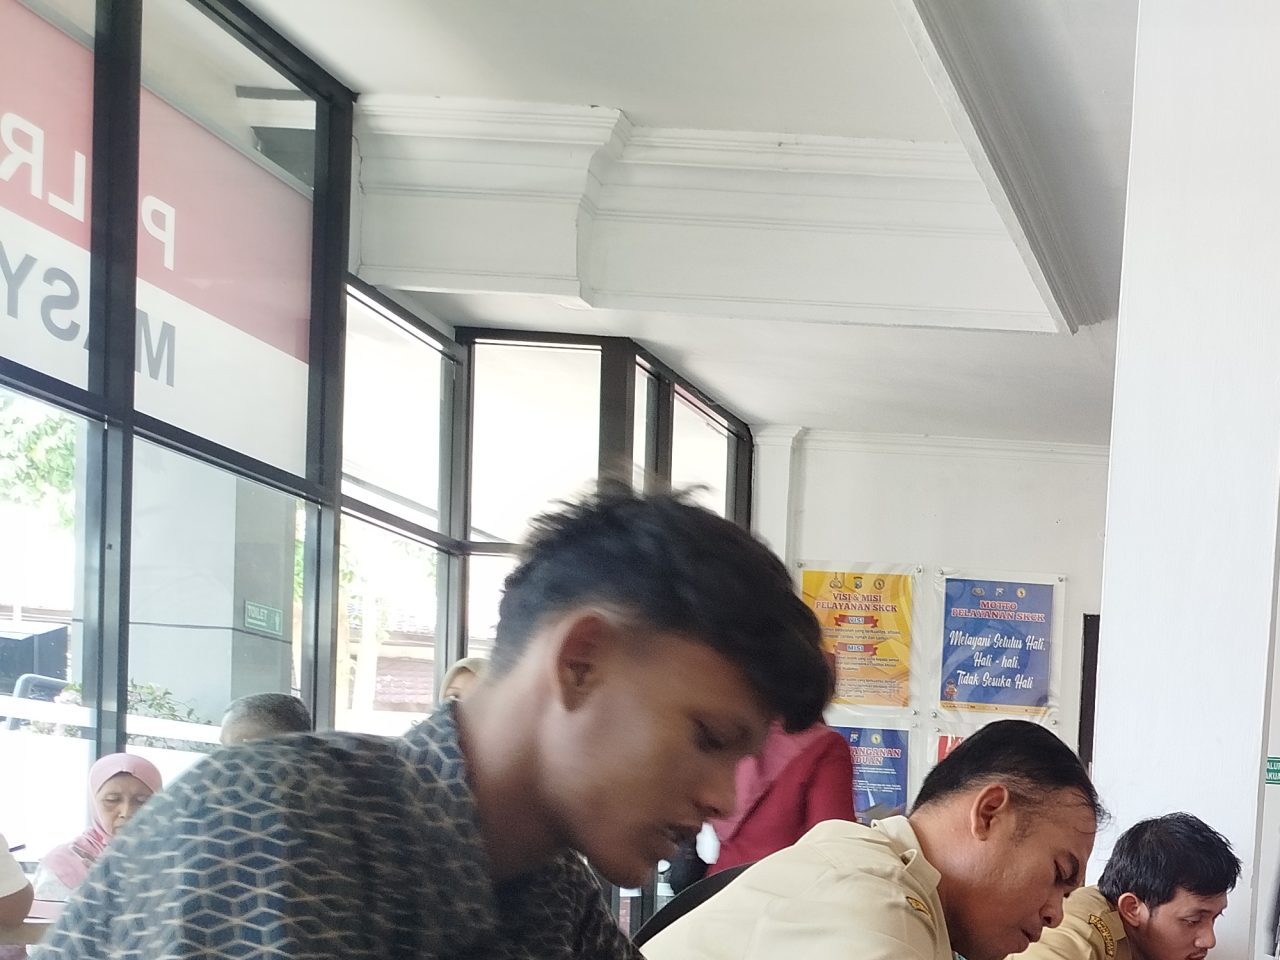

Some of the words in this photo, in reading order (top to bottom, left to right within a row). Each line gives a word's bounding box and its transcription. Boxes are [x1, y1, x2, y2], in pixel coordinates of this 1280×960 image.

[833, 592, 851, 602] VISI
[852, 593, 859, 601] &
[861, 594, 882, 603] MISI
[247, 605, 268, 620] TOILET
[816, 601, 871, 611] PELAYANAN
[872, 603, 897, 612] SKCK
[980, 600, 1018, 611] MOTTO
[951, 607, 1015, 620] PELAYANAN
[1016, 612, 1046, 622] SKCK
[949, 630, 992, 650] Melayani
[993, 633, 1023, 649] Setulus
[1025, 635, 1046, 651] Hati.
[973, 651, 993, 667] Hati
[1001, 655, 1021, 669] hati.
[956, 670, 979, 686] Tidak
[982, 672, 1012, 688] Sesuka
[1014, 674, 1034, 689] Hati
